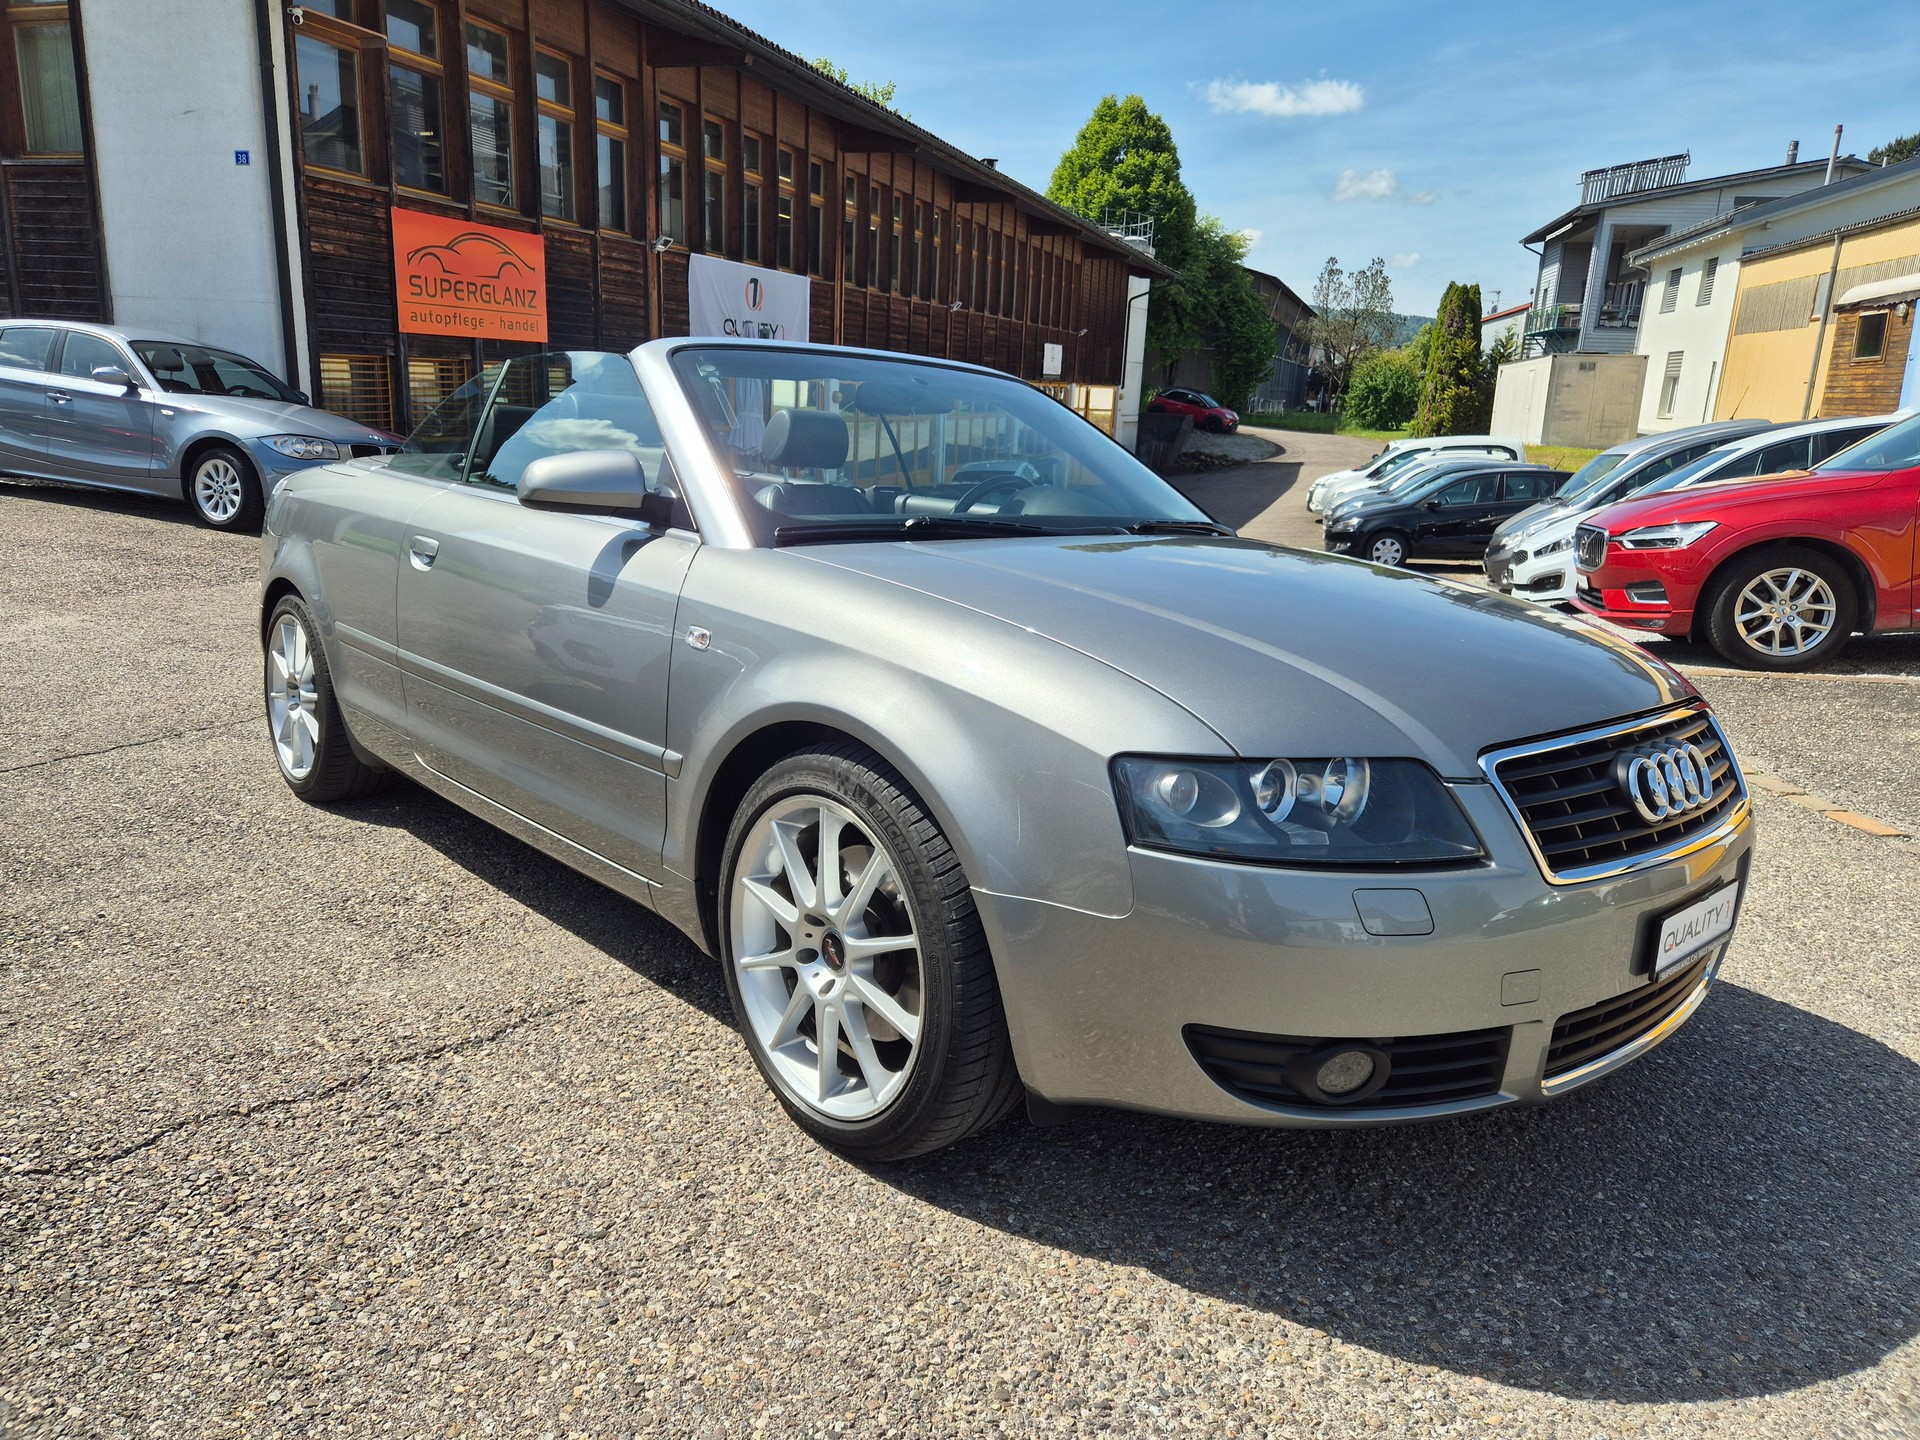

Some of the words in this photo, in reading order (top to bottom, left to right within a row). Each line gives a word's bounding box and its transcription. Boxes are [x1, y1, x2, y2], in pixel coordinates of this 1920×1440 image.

[237, 153, 247, 164] 38
[409, 274, 538, 309] SUPERGLANZ
[410, 310, 485, 330] autopflege
[500, 317, 539, 332] handel
[1663, 902, 1725, 954] QUALITY
[1725, 899, 1731, 919] 1
